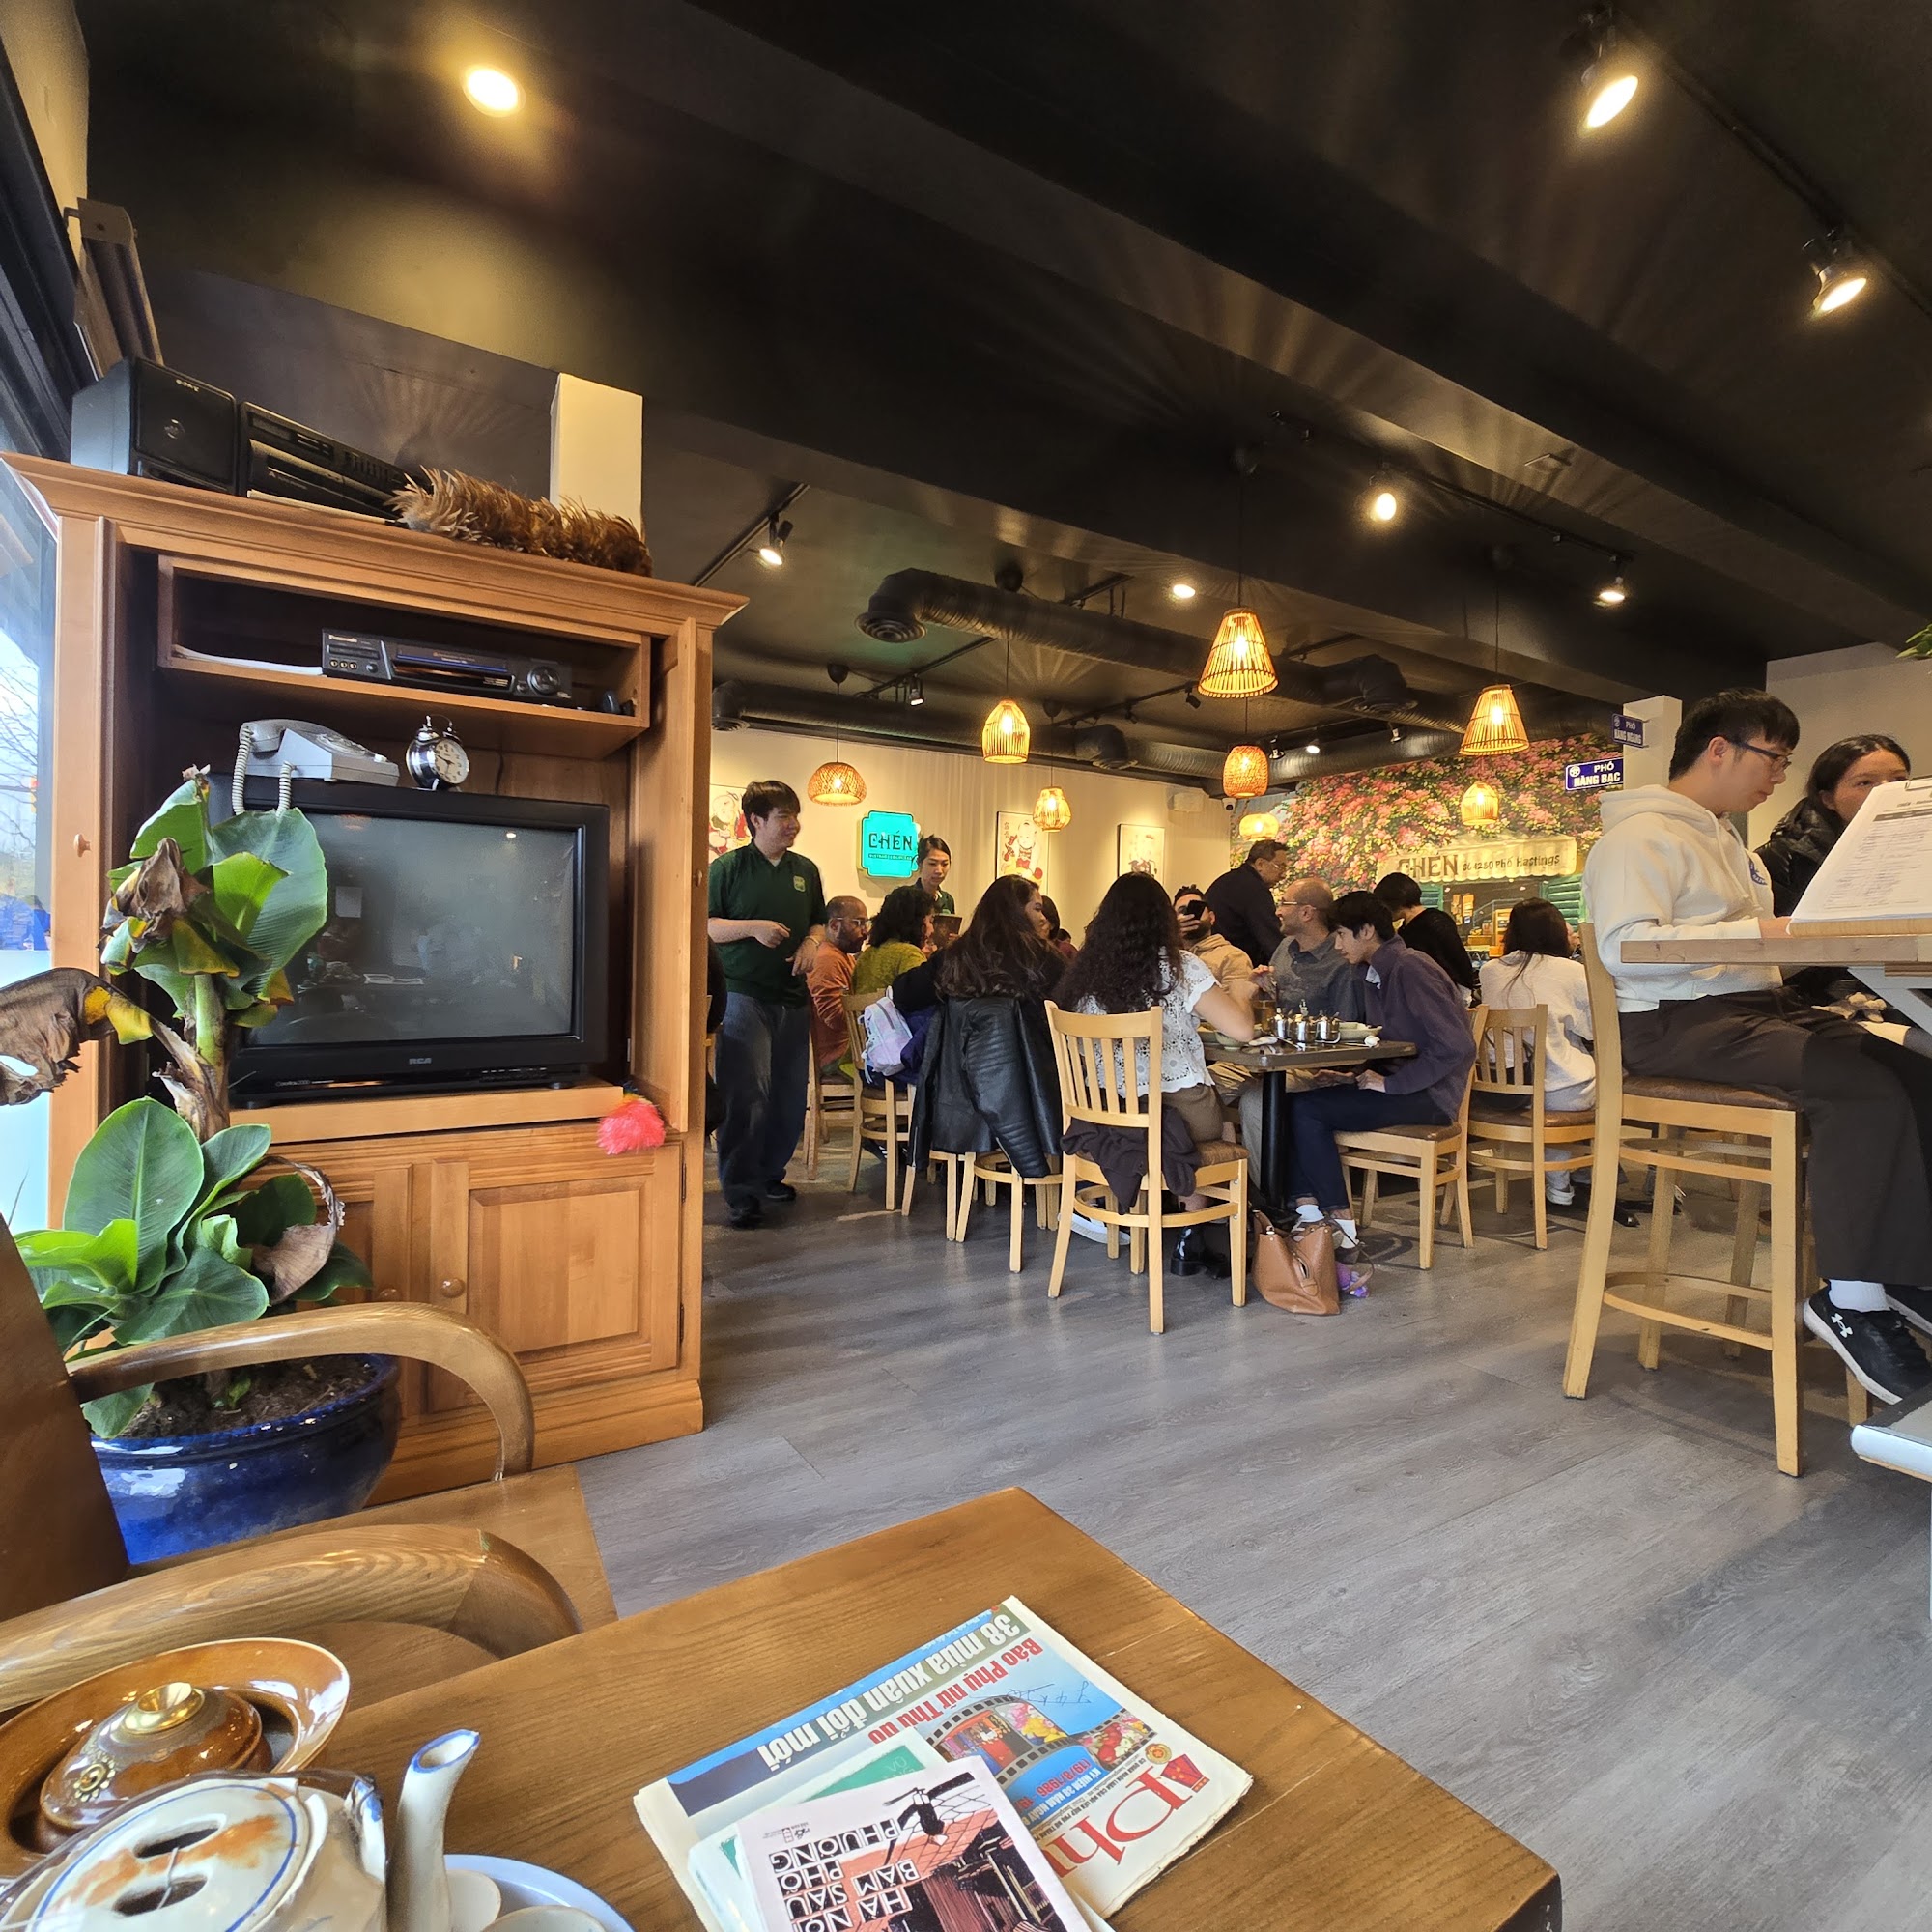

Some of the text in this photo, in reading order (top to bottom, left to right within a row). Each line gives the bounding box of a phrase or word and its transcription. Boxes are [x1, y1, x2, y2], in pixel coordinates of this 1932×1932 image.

[1574, 772, 1621, 787] HÀNG BẠC
[1594, 761, 1615, 773] PHỐ
[868, 830, 913, 851] CHÉN
[1516, 854, 1560, 867] Hastings
[1001, 1637, 1044, 1667] Báo
[962, 1660, 1009, 1692] Phụ
[756, 1614, 1021, 1772] 38 mùa xuân đổi mới
[935, 1683, 968, 1710] nữ
[1061, 1784, 1075, 1799] 38
[772, 1818, 898, 1873] PHƯỜNG
[781, 1860, 842, 1895] PHỐ
[786, 1860, 918, 1919] BĂM SÁU
[860, 1889, 906, 1919] HÀ
